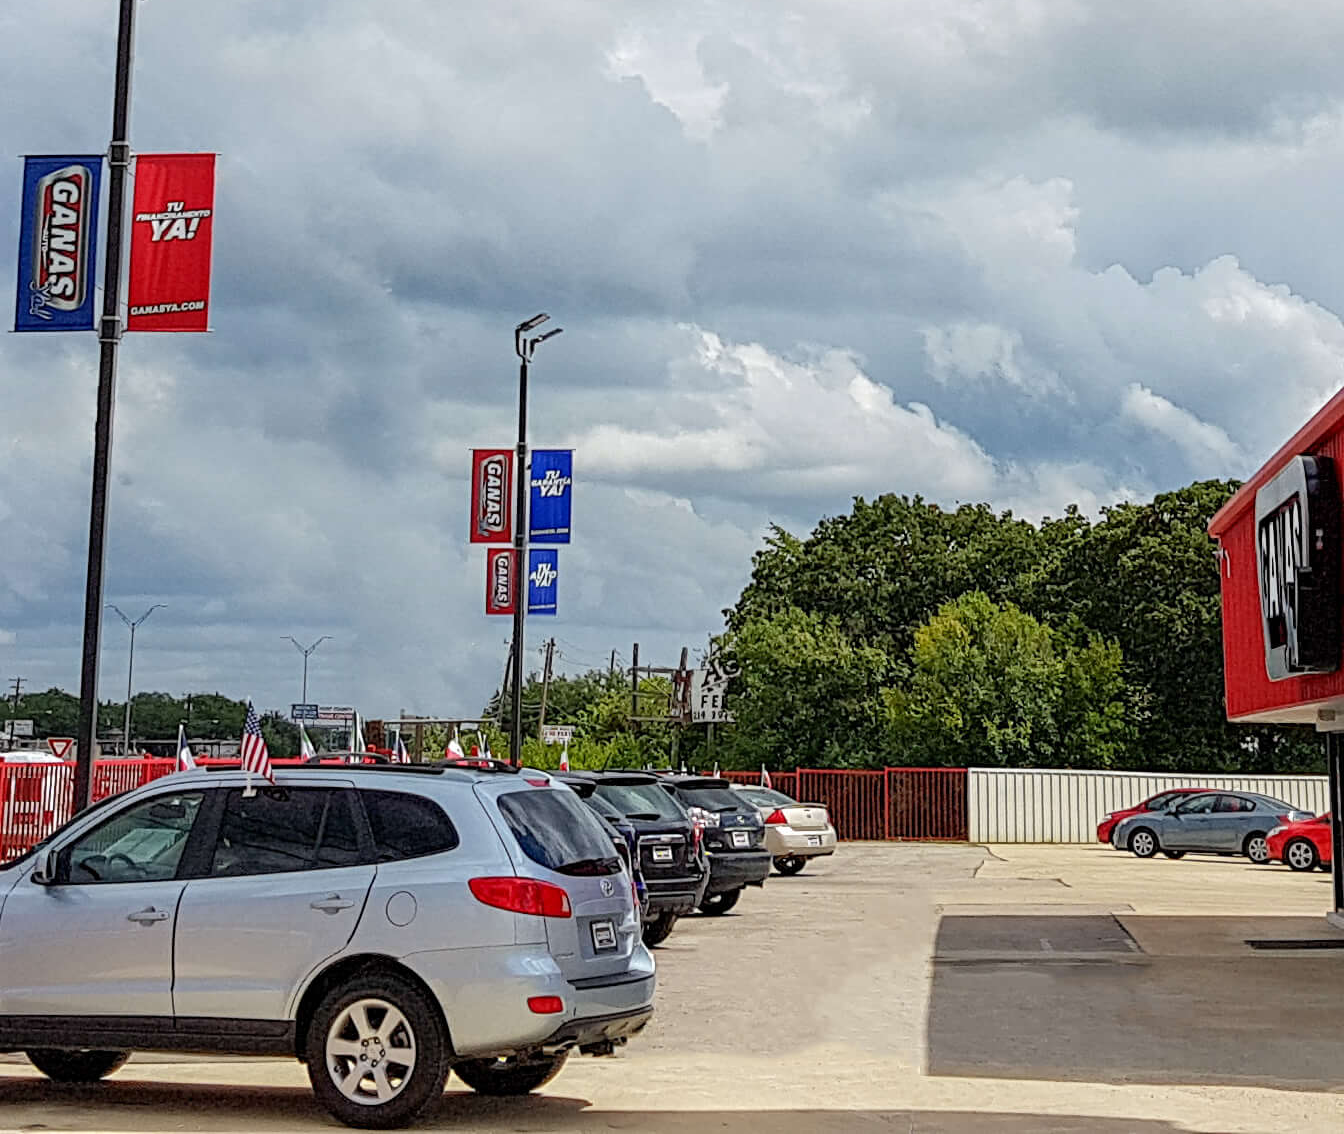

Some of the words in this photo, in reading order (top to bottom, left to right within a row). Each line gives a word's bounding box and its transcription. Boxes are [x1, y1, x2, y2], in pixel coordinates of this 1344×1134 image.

[151, 217, 201, 242] YA!
[167, 201, 185, 212] TU
[48, 180, 79, 298] GANAS
[486, 462, 502, 527] GANAS
[497, 557, 508, 602] GANAS
[1261, 498, 1302, 619] GANAS
